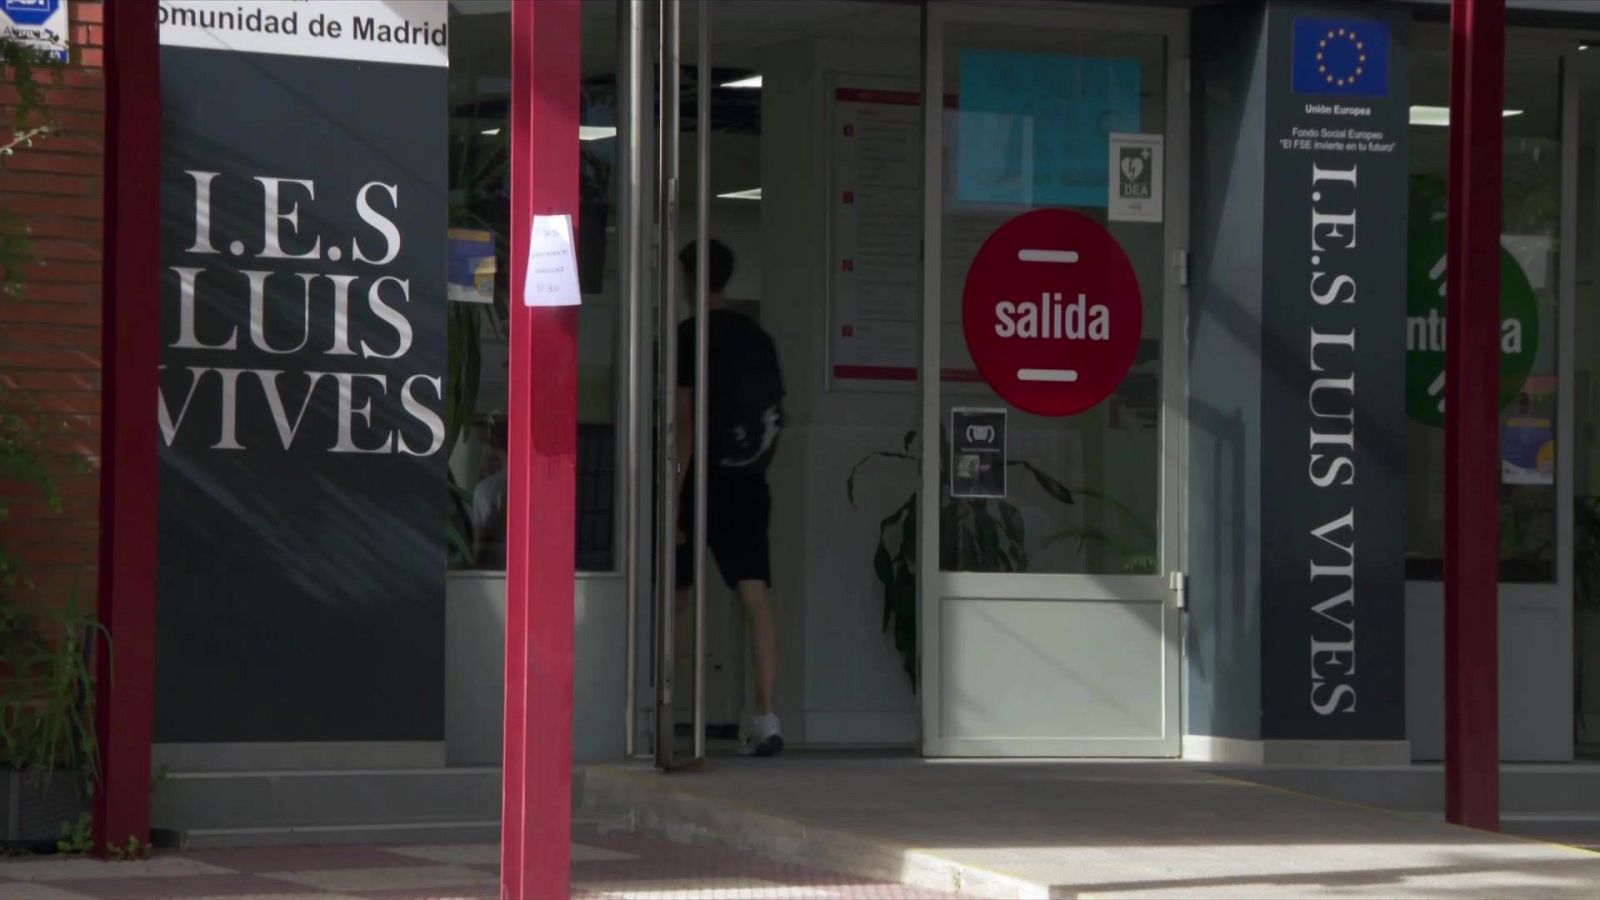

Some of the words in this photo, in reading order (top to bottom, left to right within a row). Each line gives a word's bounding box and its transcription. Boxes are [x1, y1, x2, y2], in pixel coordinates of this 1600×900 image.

[159, 5, 298, 35] omunidad
[308, 13, 342, 39] de
[353, 16, 447, 47] Madrid
[1292, 127, 1319, 138] Fondo
[1320, 128, 1346, 139] Social
[1348, 129, 1384, 141] Europeo
[1293, 139, 1313, 150] FSE
[1313, 140, 1345, 151] invierte
[1345, 142, 1357, 151] en
[1358, 142, 1368, 152] tu
[1305, 104, 1332, 114] Unión
[1333, 104, 1371, 117] Europea
[184, 169, 401, 266] I.E.S
[1124, 183, 1149, 197] DEA
[1310, 161, 1357, 306] I.E.S
[168, 266, 413, 360] LUIS
[994, 292, 1110, 341] salida
[158, 364, 446, 457] VIVES
[1308, 327, 1356, 488] LUIS
[1309, 506, 1357, 716] VIVES
